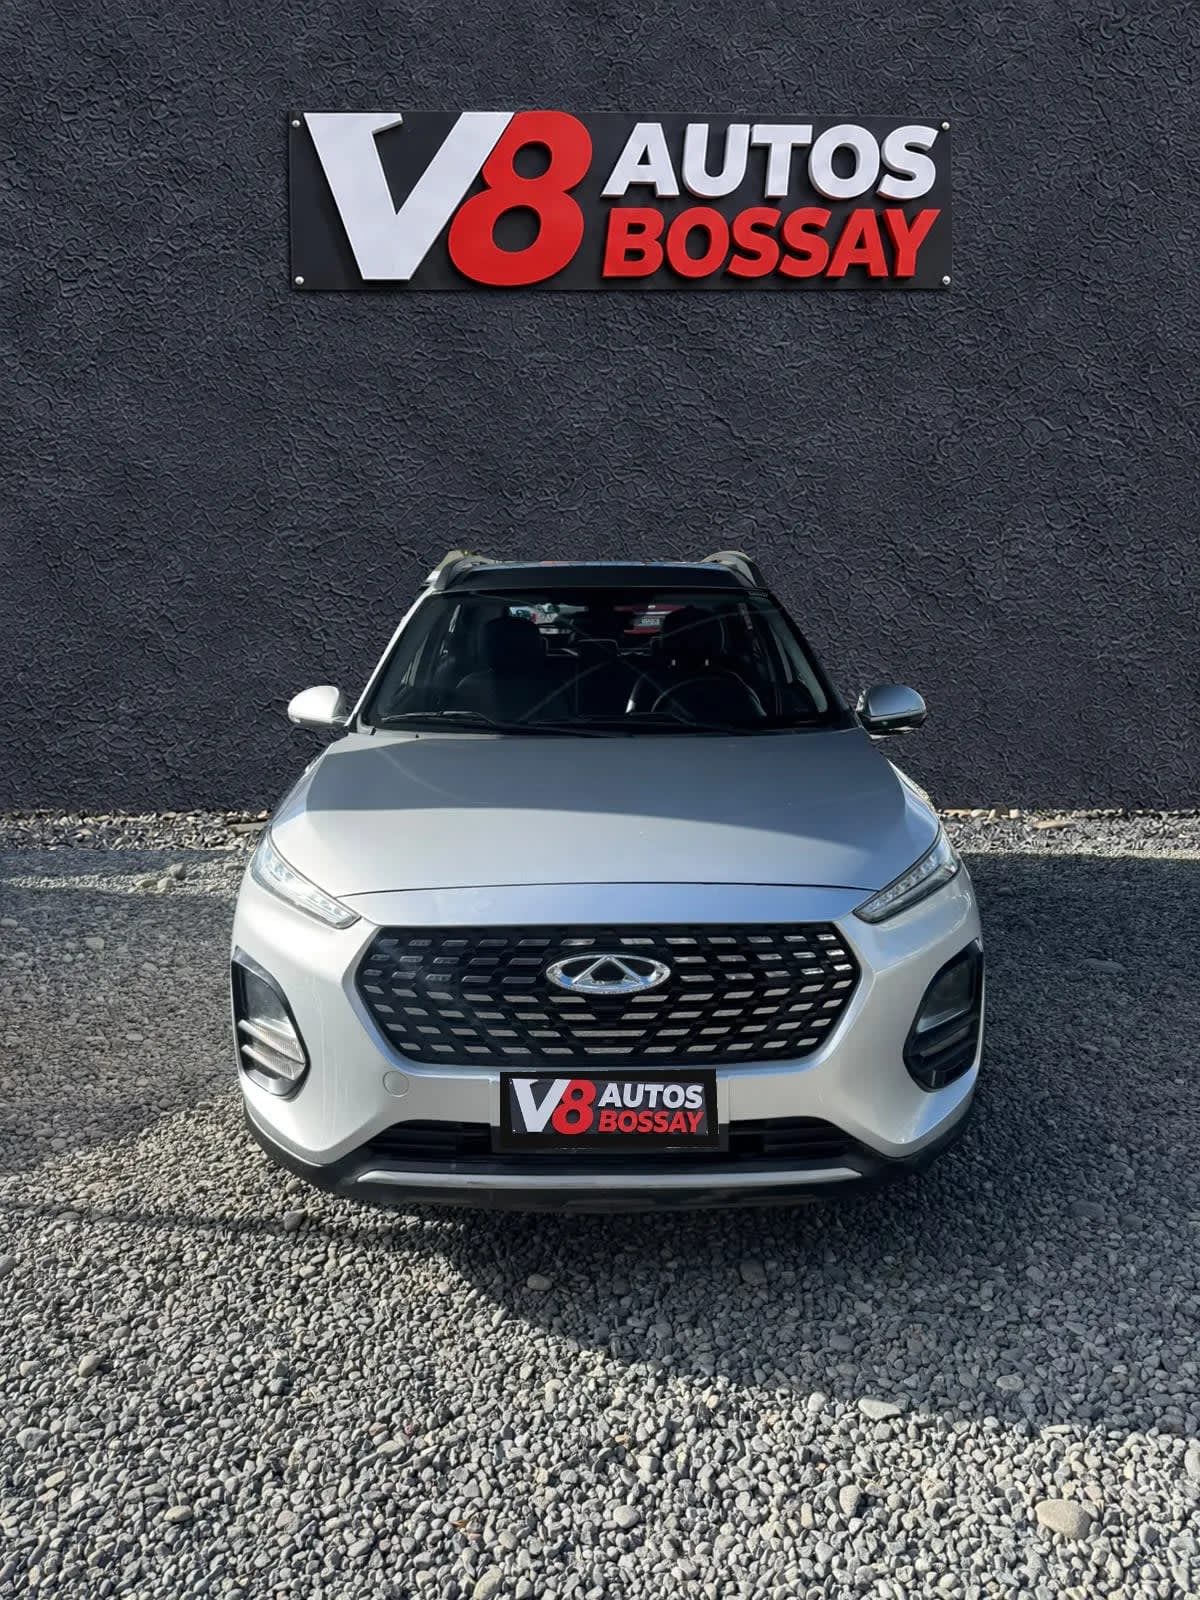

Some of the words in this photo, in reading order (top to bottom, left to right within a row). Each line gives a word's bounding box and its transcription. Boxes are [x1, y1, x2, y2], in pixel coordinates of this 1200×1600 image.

[601, 122, 938, 199] AUTOS
[303, 110, 592, 286] V8
[602, 207, 941, 278] BOSSAY
[511, 1078, 597, 1135] V8
[598, 1082, 704, 1109] AUTOS
[598, 1110, 704, 1134] BOSSAY
